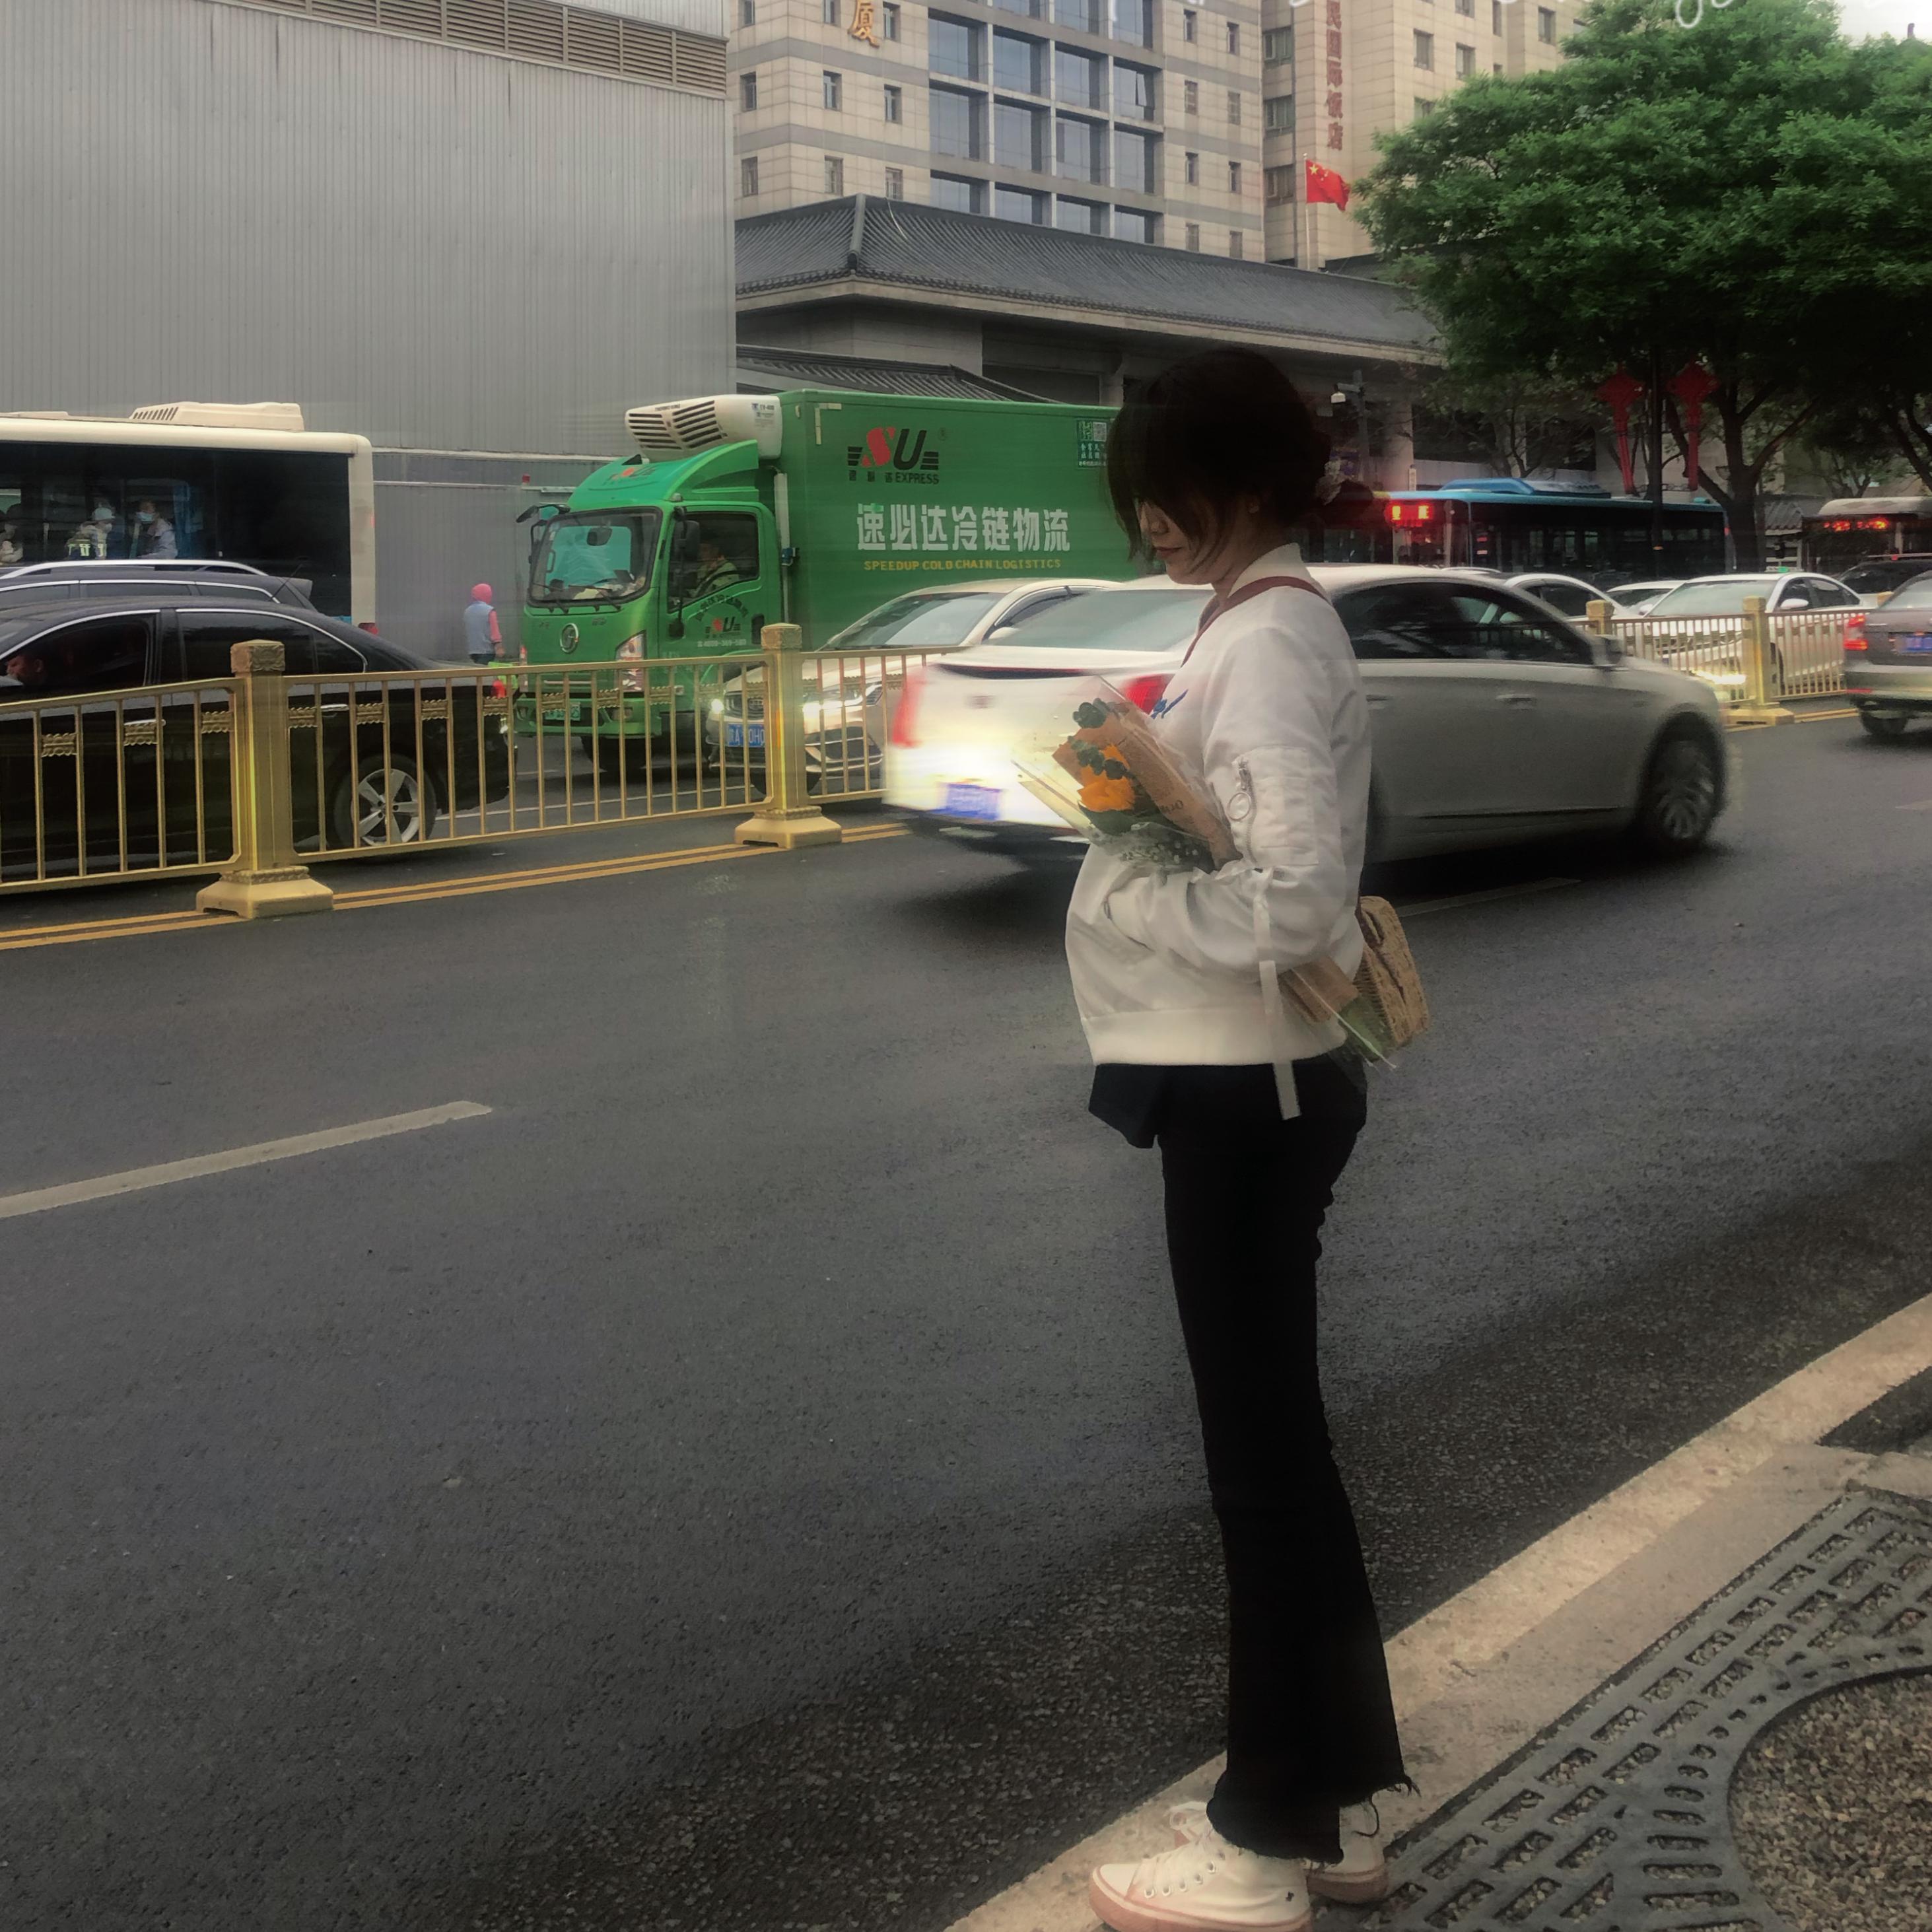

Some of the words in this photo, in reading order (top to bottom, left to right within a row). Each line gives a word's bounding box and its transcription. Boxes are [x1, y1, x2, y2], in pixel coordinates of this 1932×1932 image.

[848, 0, 880, 49] 厦
[895, 471, 939, 485] EXPRESS
[857, 503, 1070, 552] 速必达冷链物流
[864, 561, 920, 571] SPEEDUP
[922, 561, 953, 571] COLD
[955, 560, 993, 570] CHAIN
[995, 559, 1062, 570] LOGISTICS
